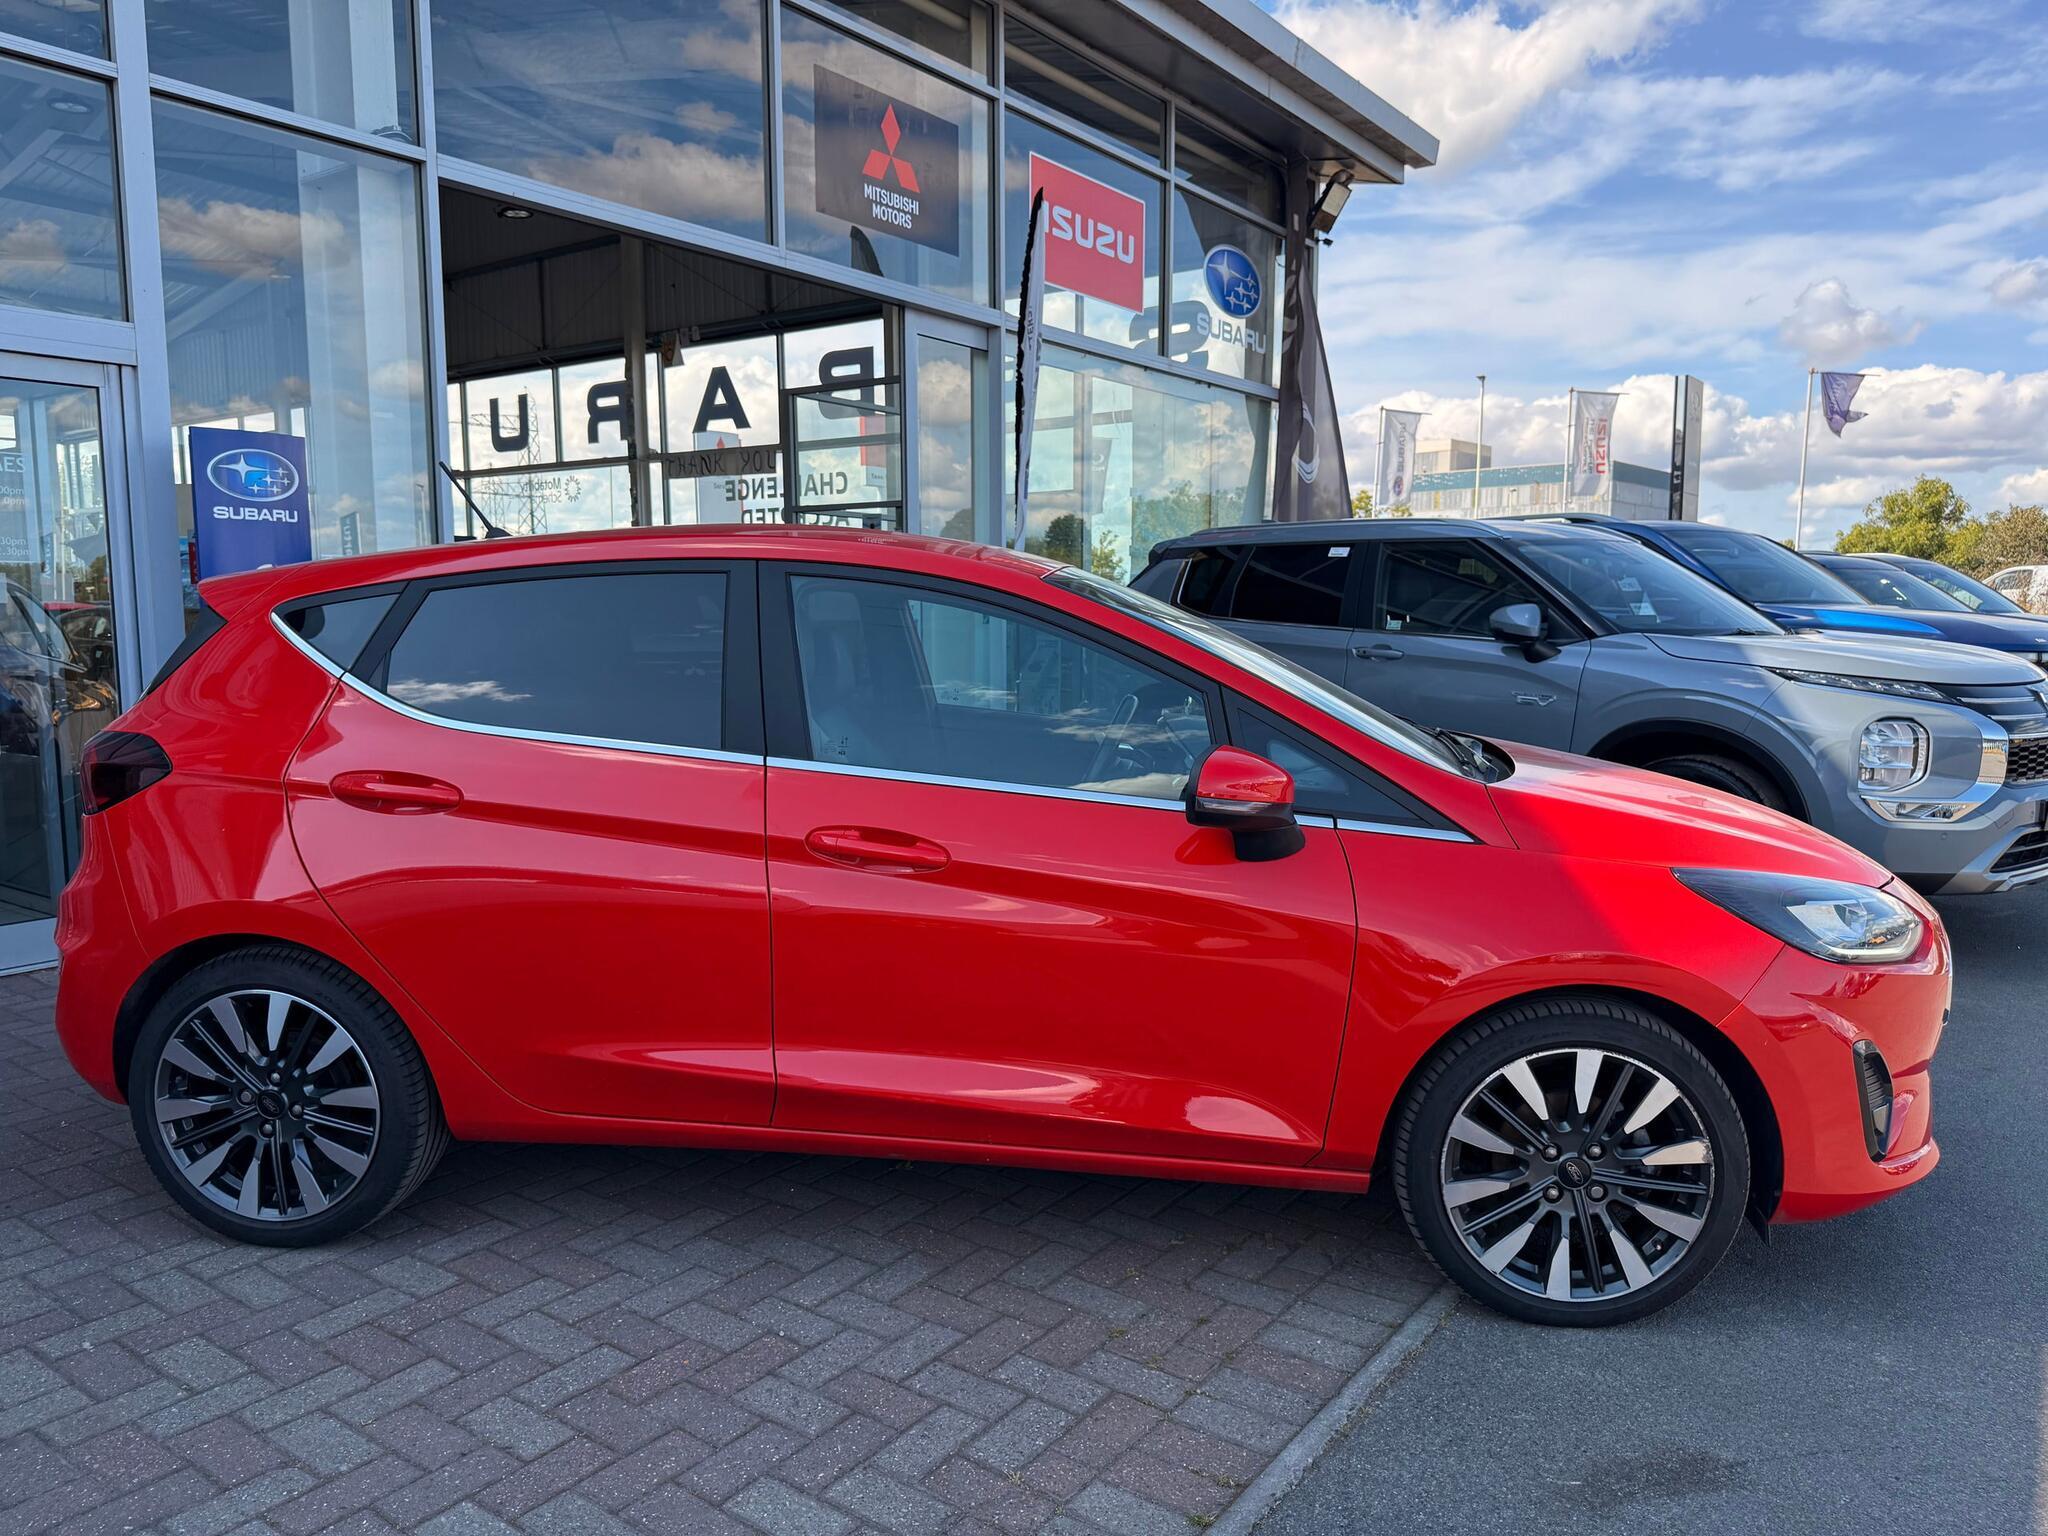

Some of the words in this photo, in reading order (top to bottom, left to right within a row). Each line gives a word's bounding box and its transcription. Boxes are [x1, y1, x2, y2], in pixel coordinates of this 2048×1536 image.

[864, 183, 919, 216] MITSUBISHI
[872, 203, 912, 229] MOTORS
[1042, 200, 1135, 264] ISUZU
[1197, 312, 1267, 354] SUBARU
[1595, 418, 1608, 475] ISUZU
[0, 456, 25, 473] ES
[666, 453, 724, 476] THANK
[740, 450, 776, 472] YOU
[213, 506, 298, 523] SUBARU
